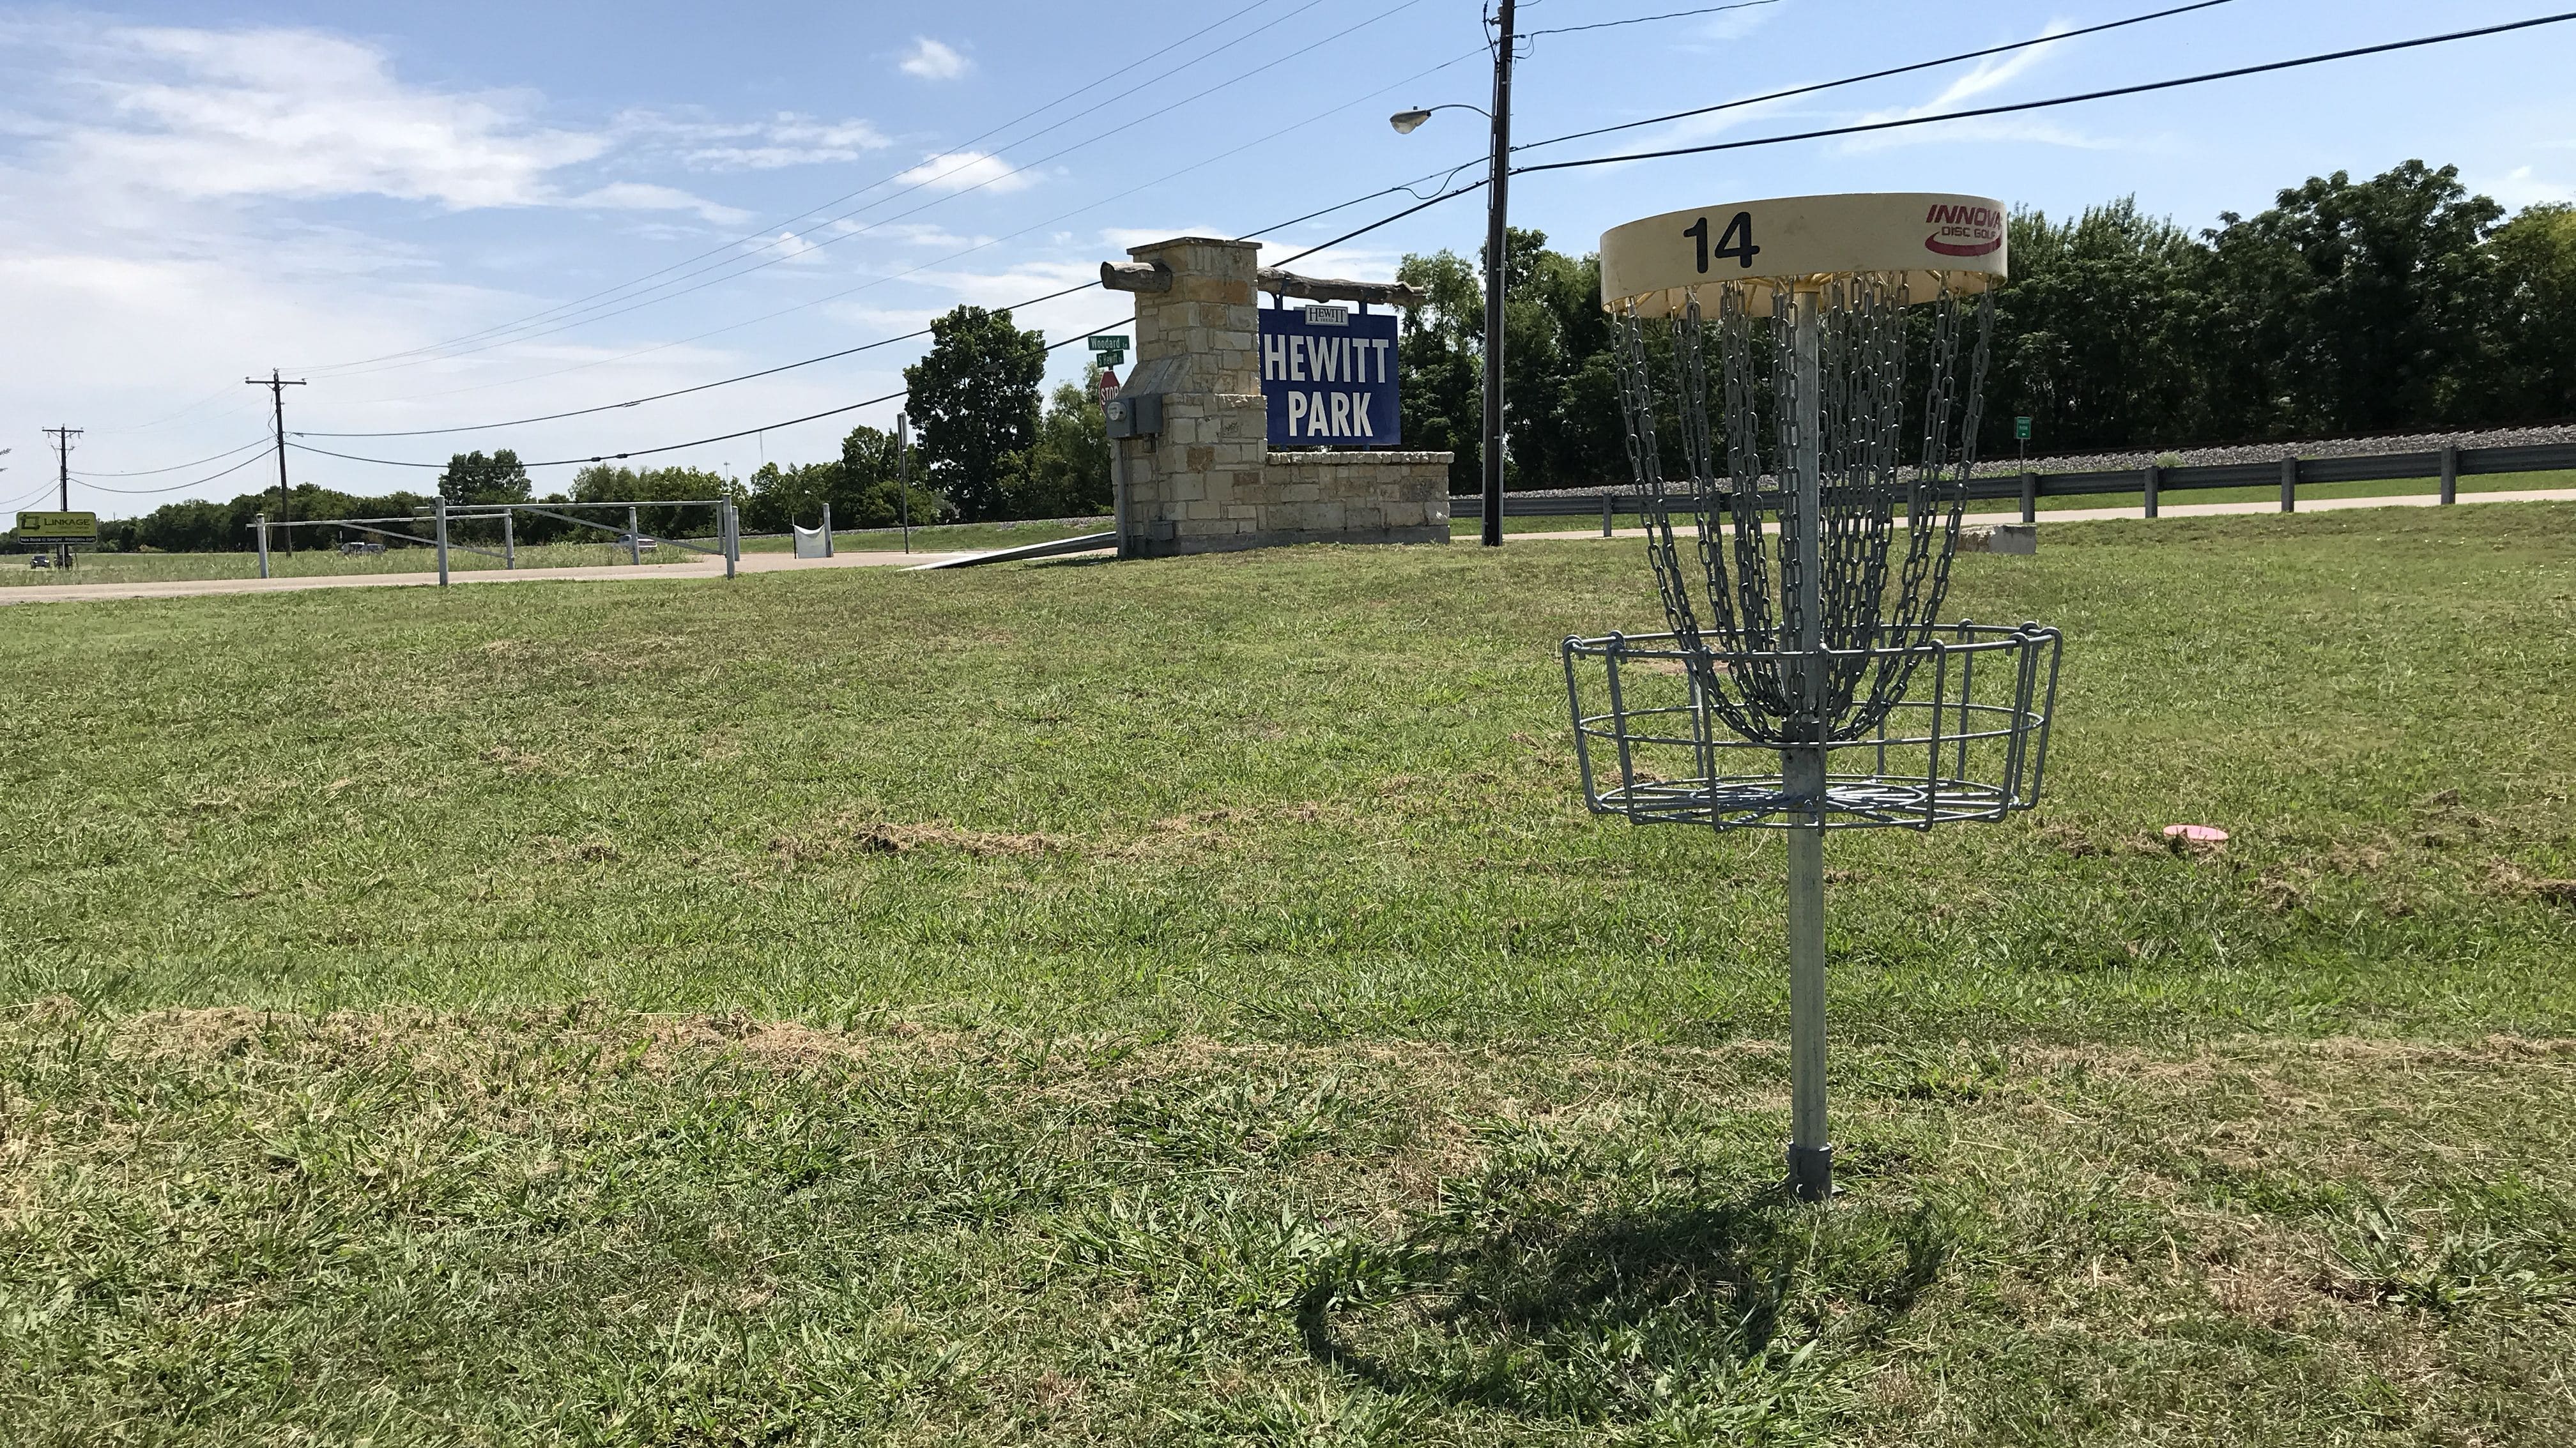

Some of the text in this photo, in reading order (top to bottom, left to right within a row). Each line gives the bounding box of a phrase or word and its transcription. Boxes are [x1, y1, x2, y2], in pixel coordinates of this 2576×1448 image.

[1926, 204, 2001, 230] INNOVA
[1683, 211, 1761, 273] 14
[1941, 226, 1996, 239] DISC GOLF
[1308, 307, 1346, 323] HEWITT
[1091, 337, 1120, 349] Woodard
[1098, 354, 1102, 366] S
[1264, 334, 1389, 383] HEWITT
[1101, 386, 1119, 406] STOP
[1288, 391, 1373, 436] PARK
